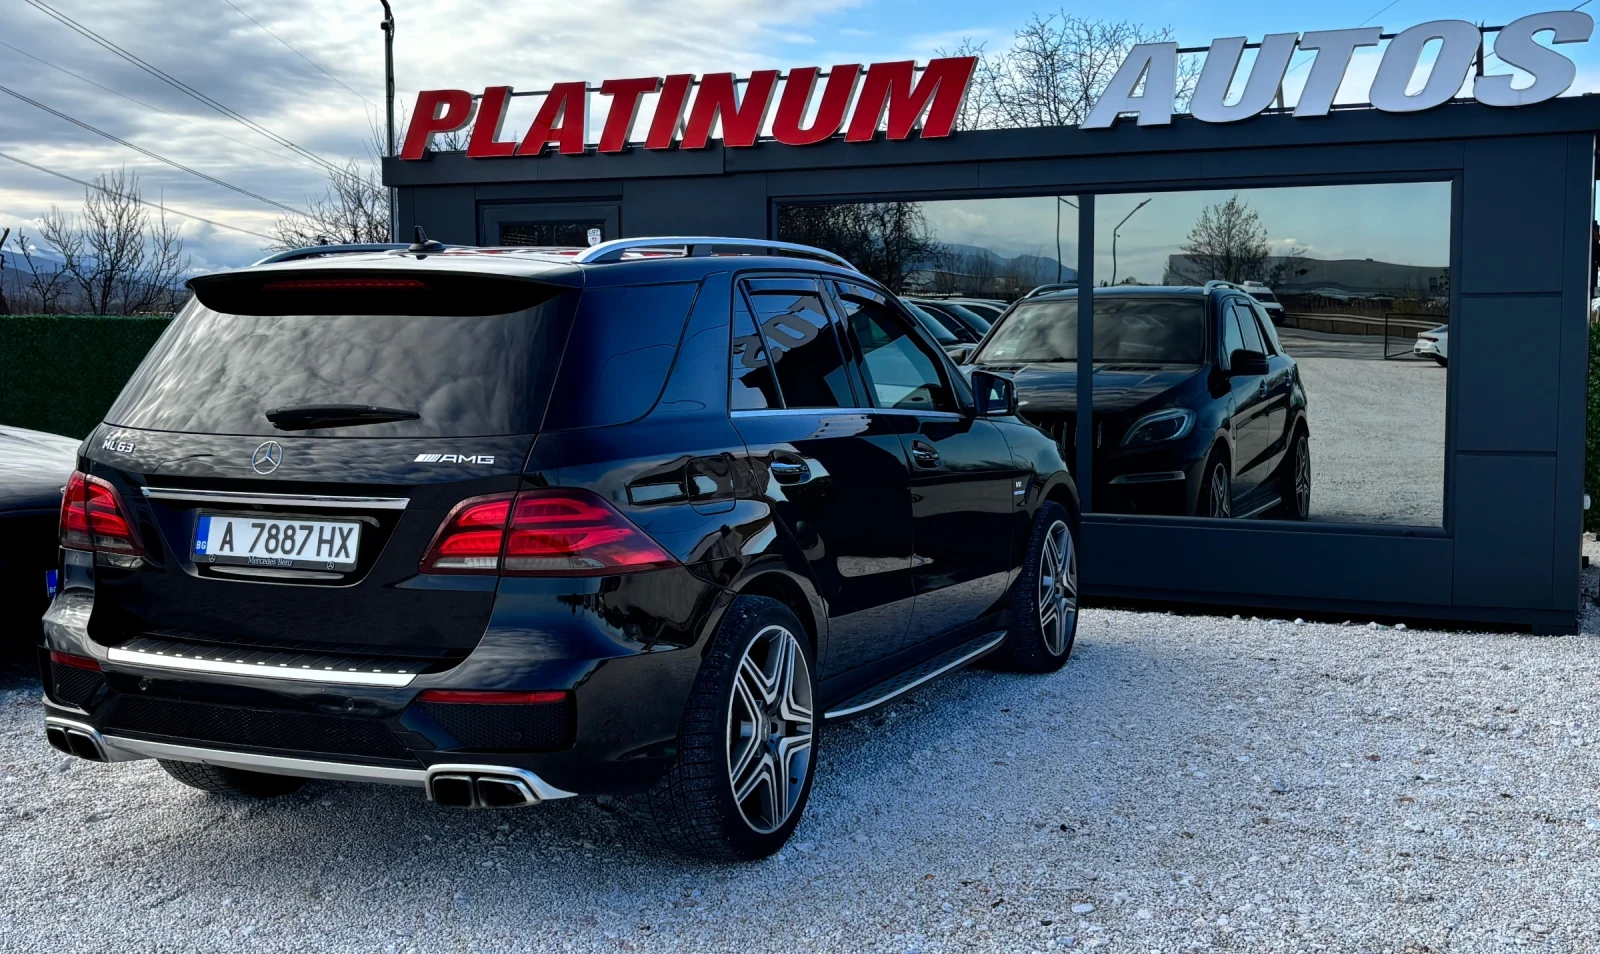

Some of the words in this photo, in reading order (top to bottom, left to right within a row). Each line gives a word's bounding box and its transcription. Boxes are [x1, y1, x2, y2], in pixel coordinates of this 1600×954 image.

[399, 56, 978, 161] PLATINUM
[1079, 10, 1595, 130] AUTOS
[438, 454, 496, 464] AMG
[196, 540, 207, 550] BG
[218, 521, 235, 552] A
